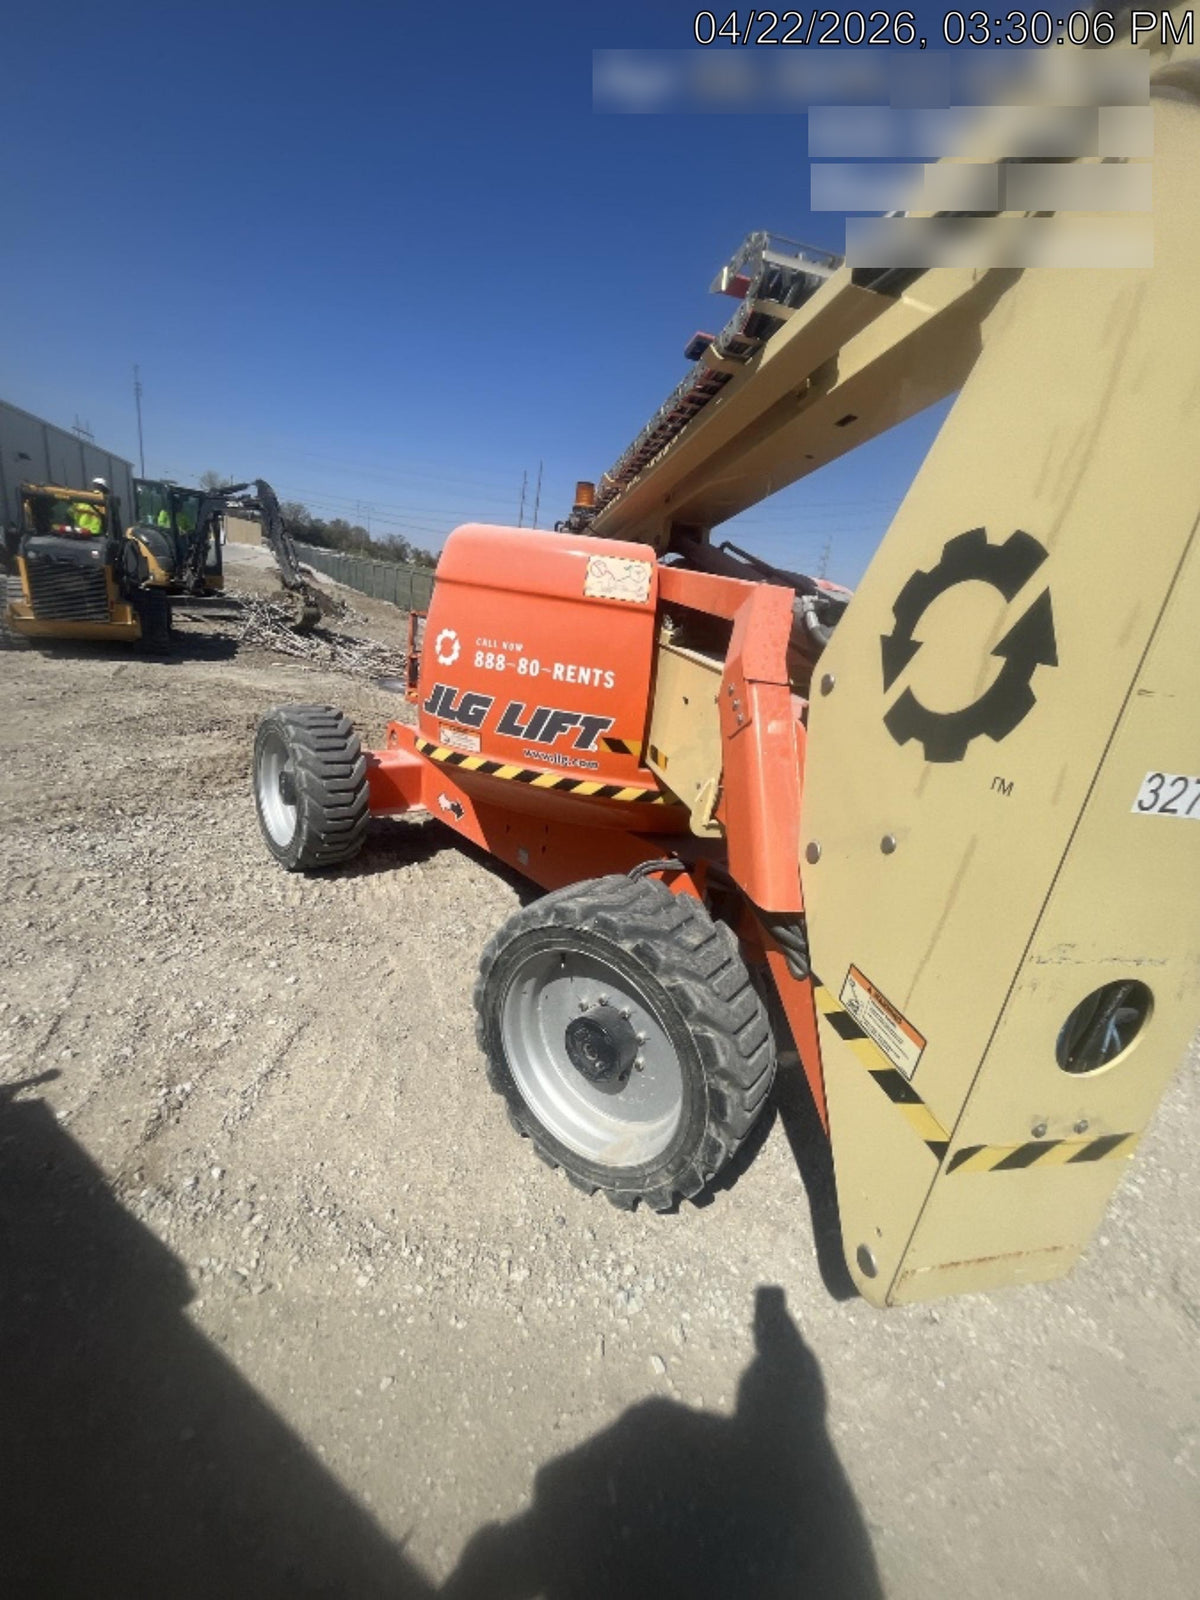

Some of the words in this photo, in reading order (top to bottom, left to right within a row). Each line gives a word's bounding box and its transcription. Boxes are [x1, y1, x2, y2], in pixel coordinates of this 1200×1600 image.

[475, 637, 498, 649] CALL
[502, 641, 524, 652] NOW
[474, 650, 616, 689] 888-80-RENTS
[423, 682, 496, 729] JLG
